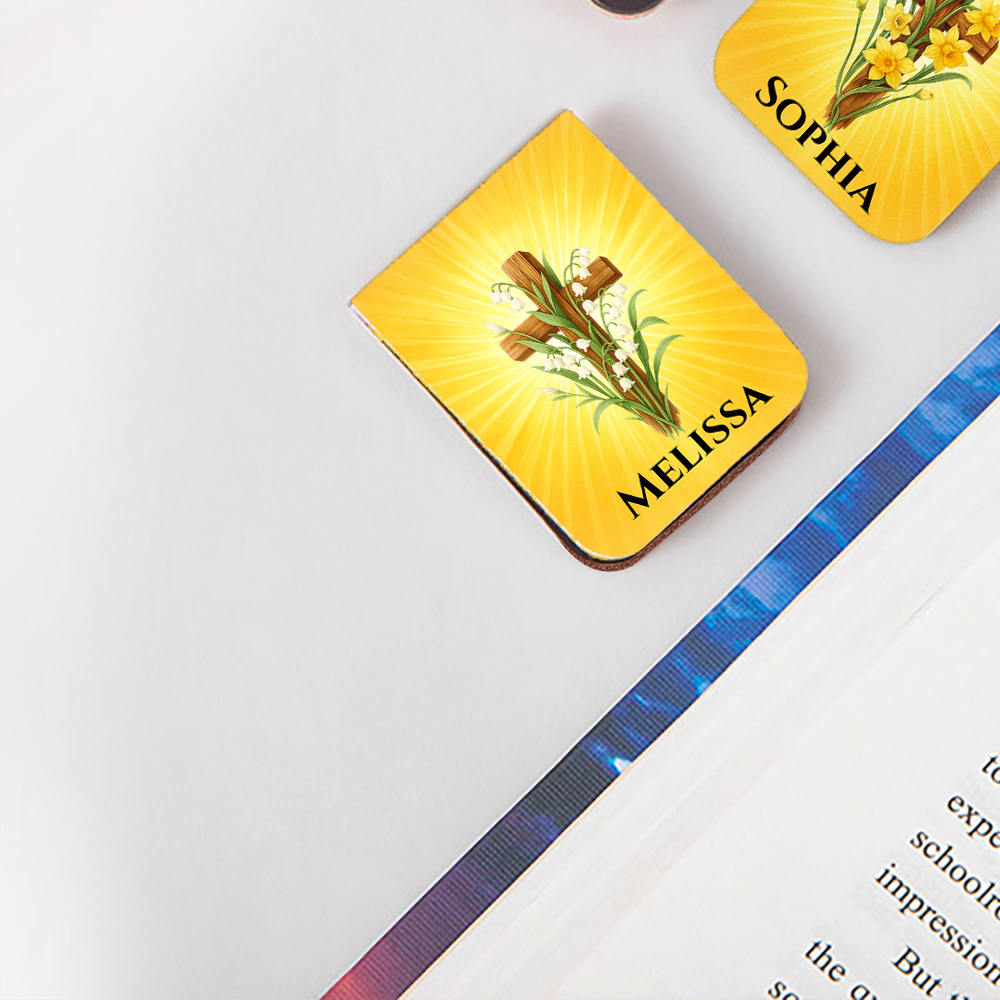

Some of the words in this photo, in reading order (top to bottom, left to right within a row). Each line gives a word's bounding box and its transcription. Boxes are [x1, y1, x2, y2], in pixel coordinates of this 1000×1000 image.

[755, 75, 878, 215] SOPHIA
[616, 385, 775, 520] MELISSA
[804, 940, 847, 983] the
[892, 945, 943, 997] But
